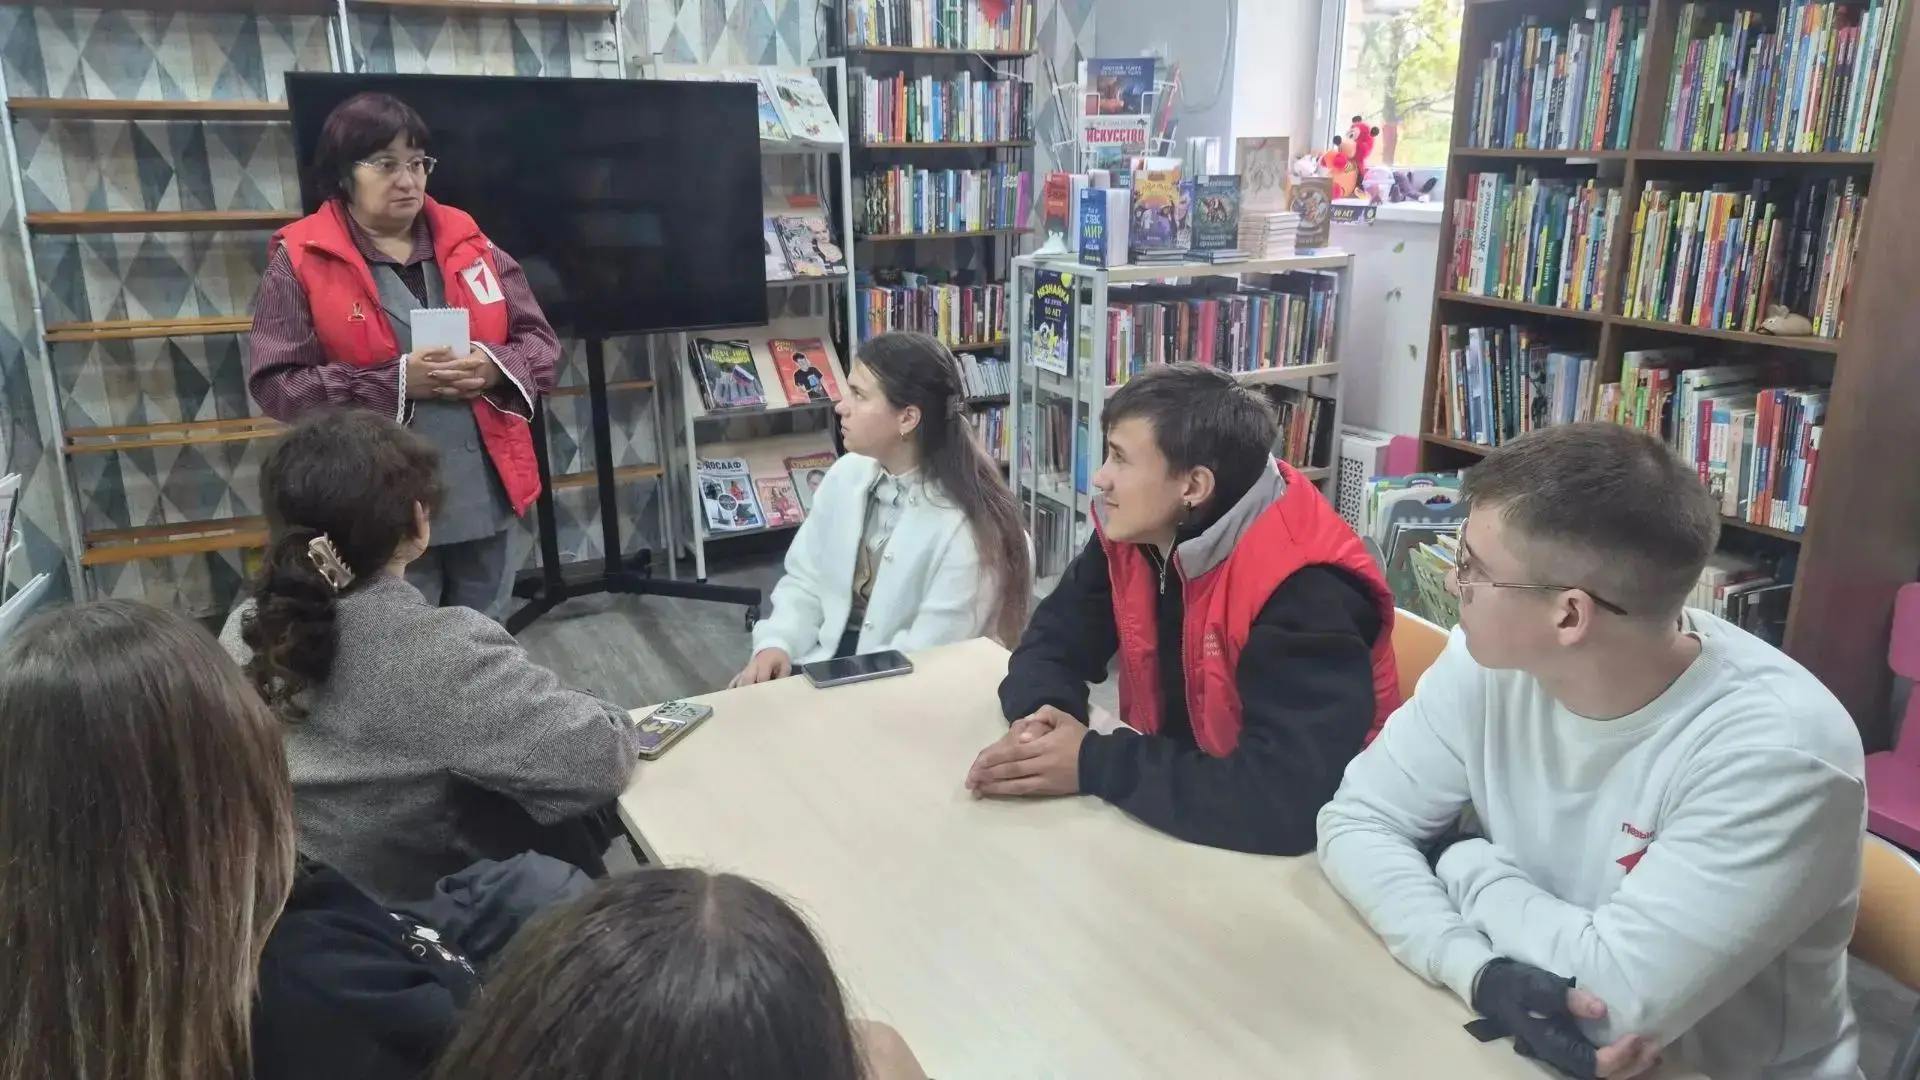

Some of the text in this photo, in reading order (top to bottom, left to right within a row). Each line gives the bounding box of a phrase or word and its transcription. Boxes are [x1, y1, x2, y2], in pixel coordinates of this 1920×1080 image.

[1086, 129, 1145, 143] ИСКУССТВО
[1083, 225, 1103, 239] МИР
[1036, 284, 1070, 304] НЕЗНАЙКА
